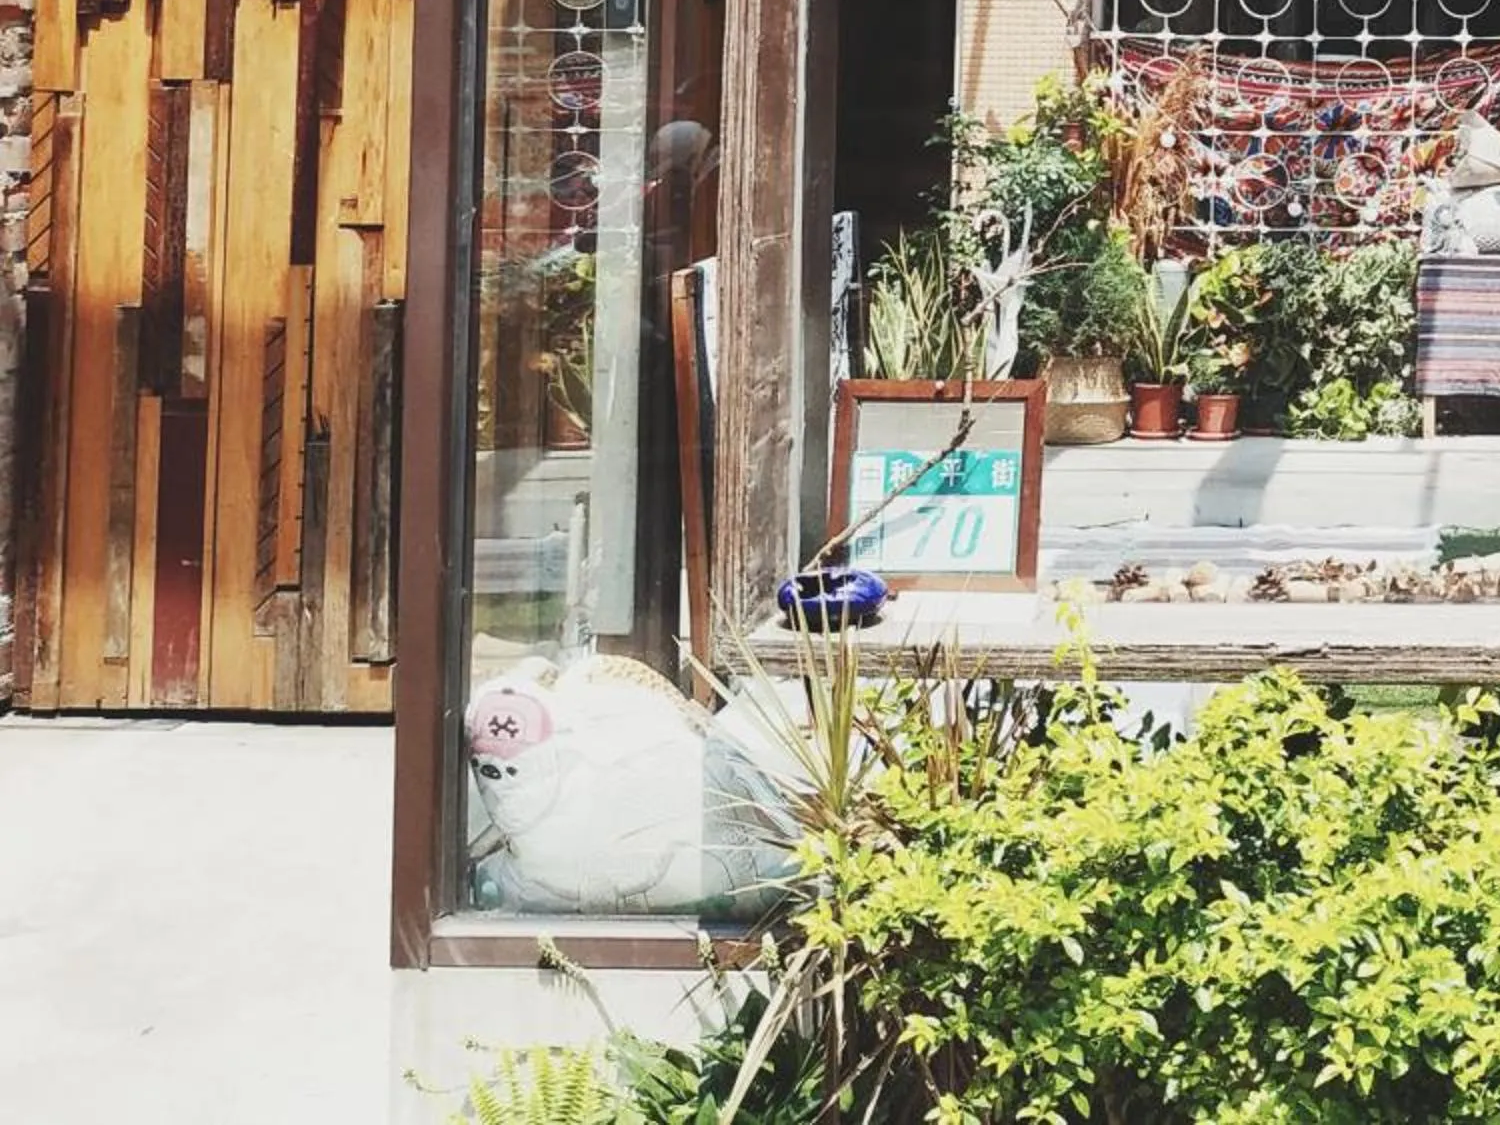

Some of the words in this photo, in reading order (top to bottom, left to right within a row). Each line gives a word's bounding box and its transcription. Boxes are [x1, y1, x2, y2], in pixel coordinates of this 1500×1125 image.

[889, 455, 1017, 490] 和平街
[911, 504, 986, 559] 70
